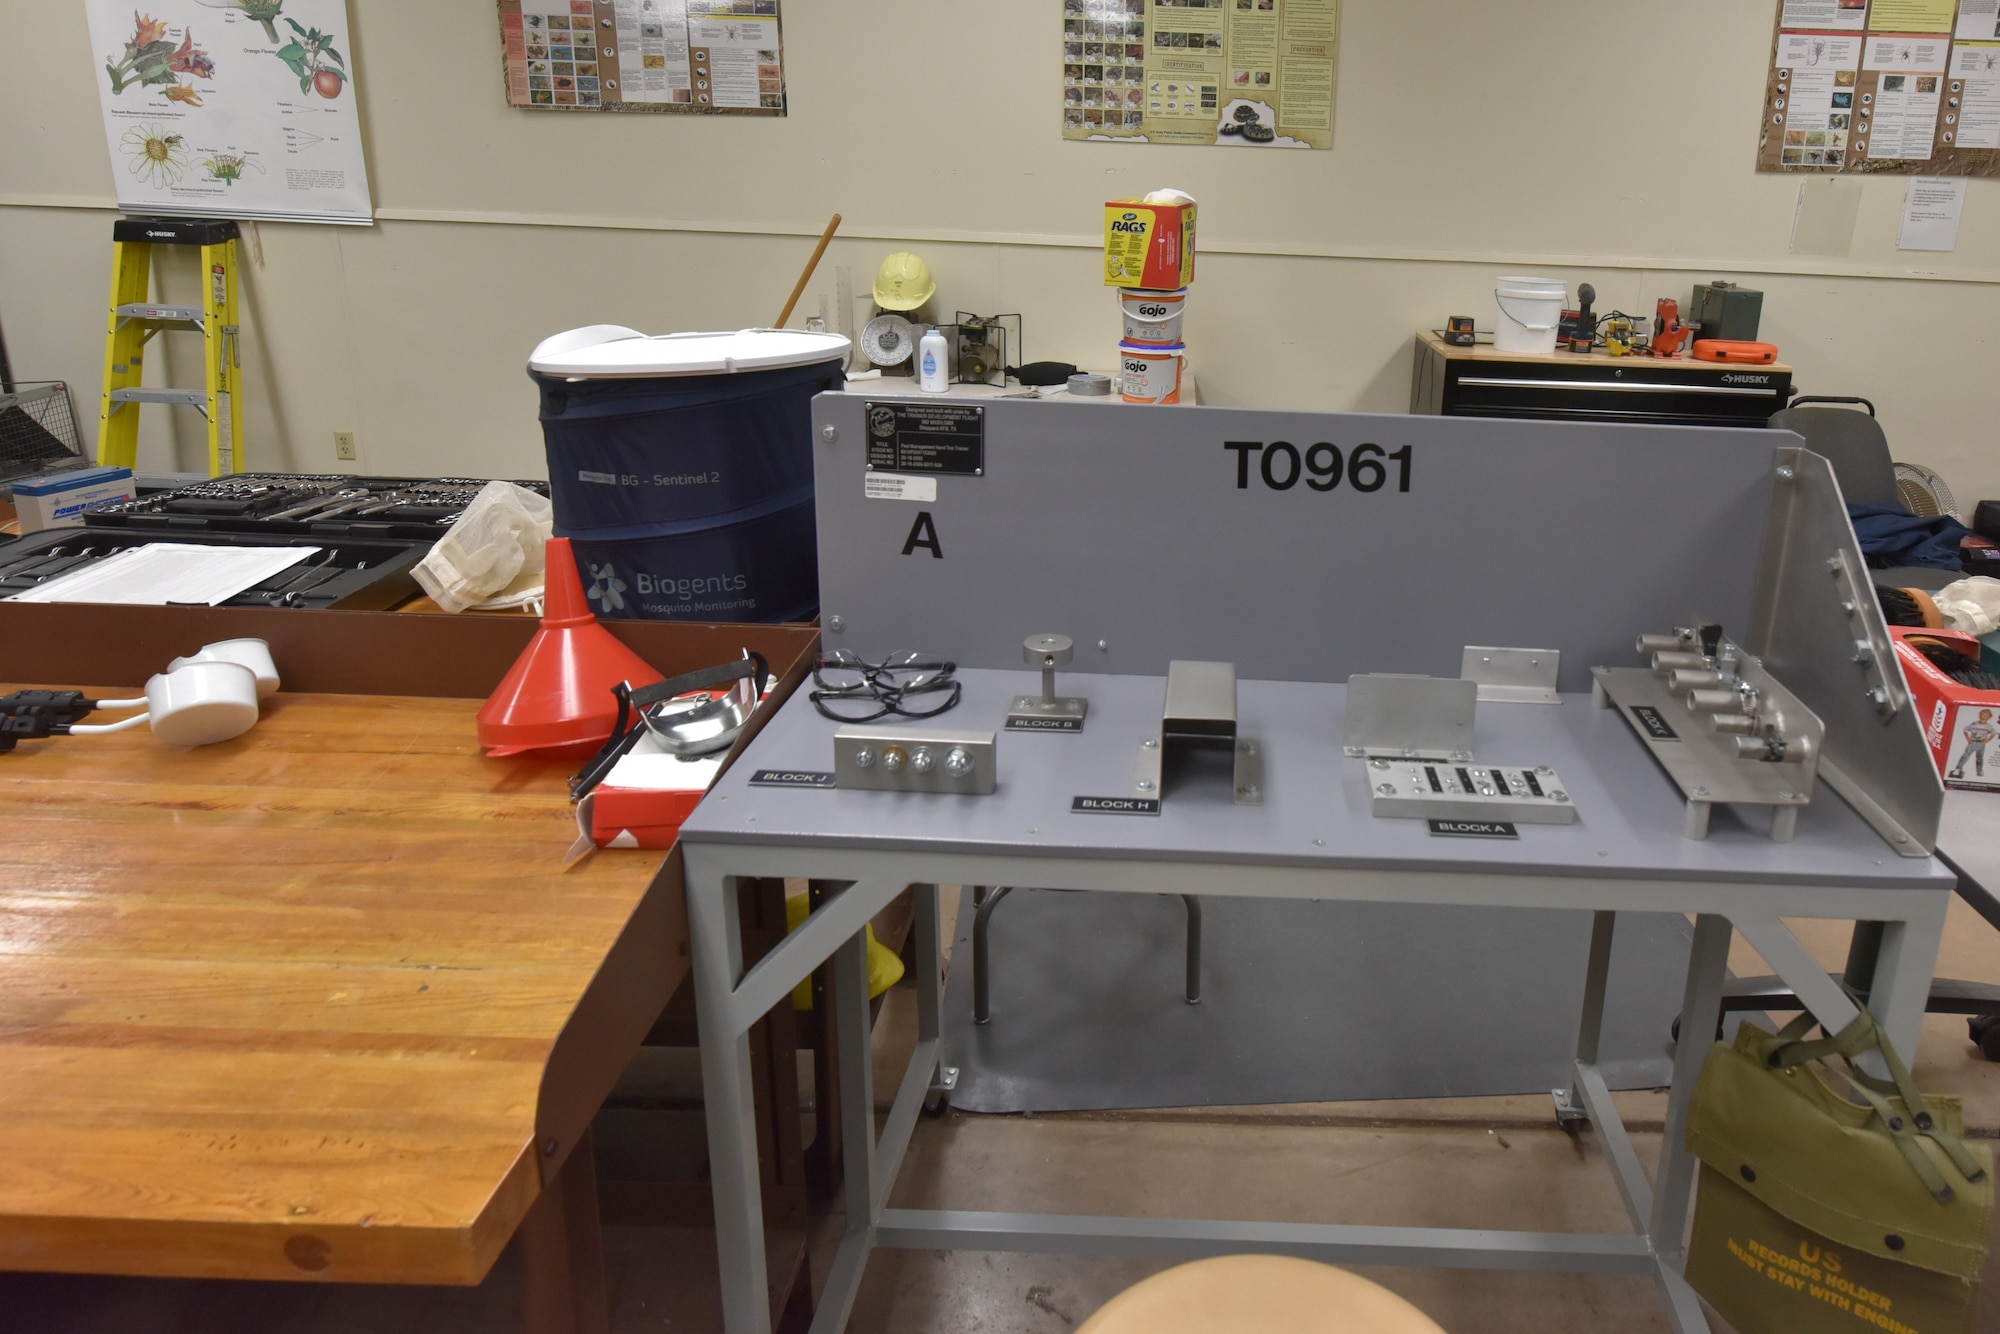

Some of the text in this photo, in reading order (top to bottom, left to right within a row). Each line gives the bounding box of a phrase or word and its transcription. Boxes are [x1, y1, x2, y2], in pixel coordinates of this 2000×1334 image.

[1292, 46, 1323, 54] PREVENTION
[1165, 61, 1202, 69] IDENTIFICATION
[1111, 221, 1147, 233] RAGS
[1734, 375, 1769, 384] HUSKY
[1224, 441, 1412, 493] T0961
[621, 474, 638, 486] BG
[653, 472, 708, 486] Sentinel
[711, 472, 720, 483] 2
[54, 503, 86, 516] POWER
[901, 511, 944, 559] A
[637, 573, 747, 600] Biogents
[642, 598, 756, 615] Mosquito Monitoring
[1639, 709, 1664, 729] BLOCK
[763, 773, 816, 782] BLOCK
[1082, 799, 1149, 809] BLOCK H
[1438, 822, 1506, 833] BLOCK A
[1799, 1240, 1843, 1273] US
[1728, 1238, 1764, 1273] MUST
[1766, 1267, 1806, 1292] STAY
[1809, 1285, 1851, 1311] WITH
[1749, 1239, 1892, 1312] RECORDS HOLDER
